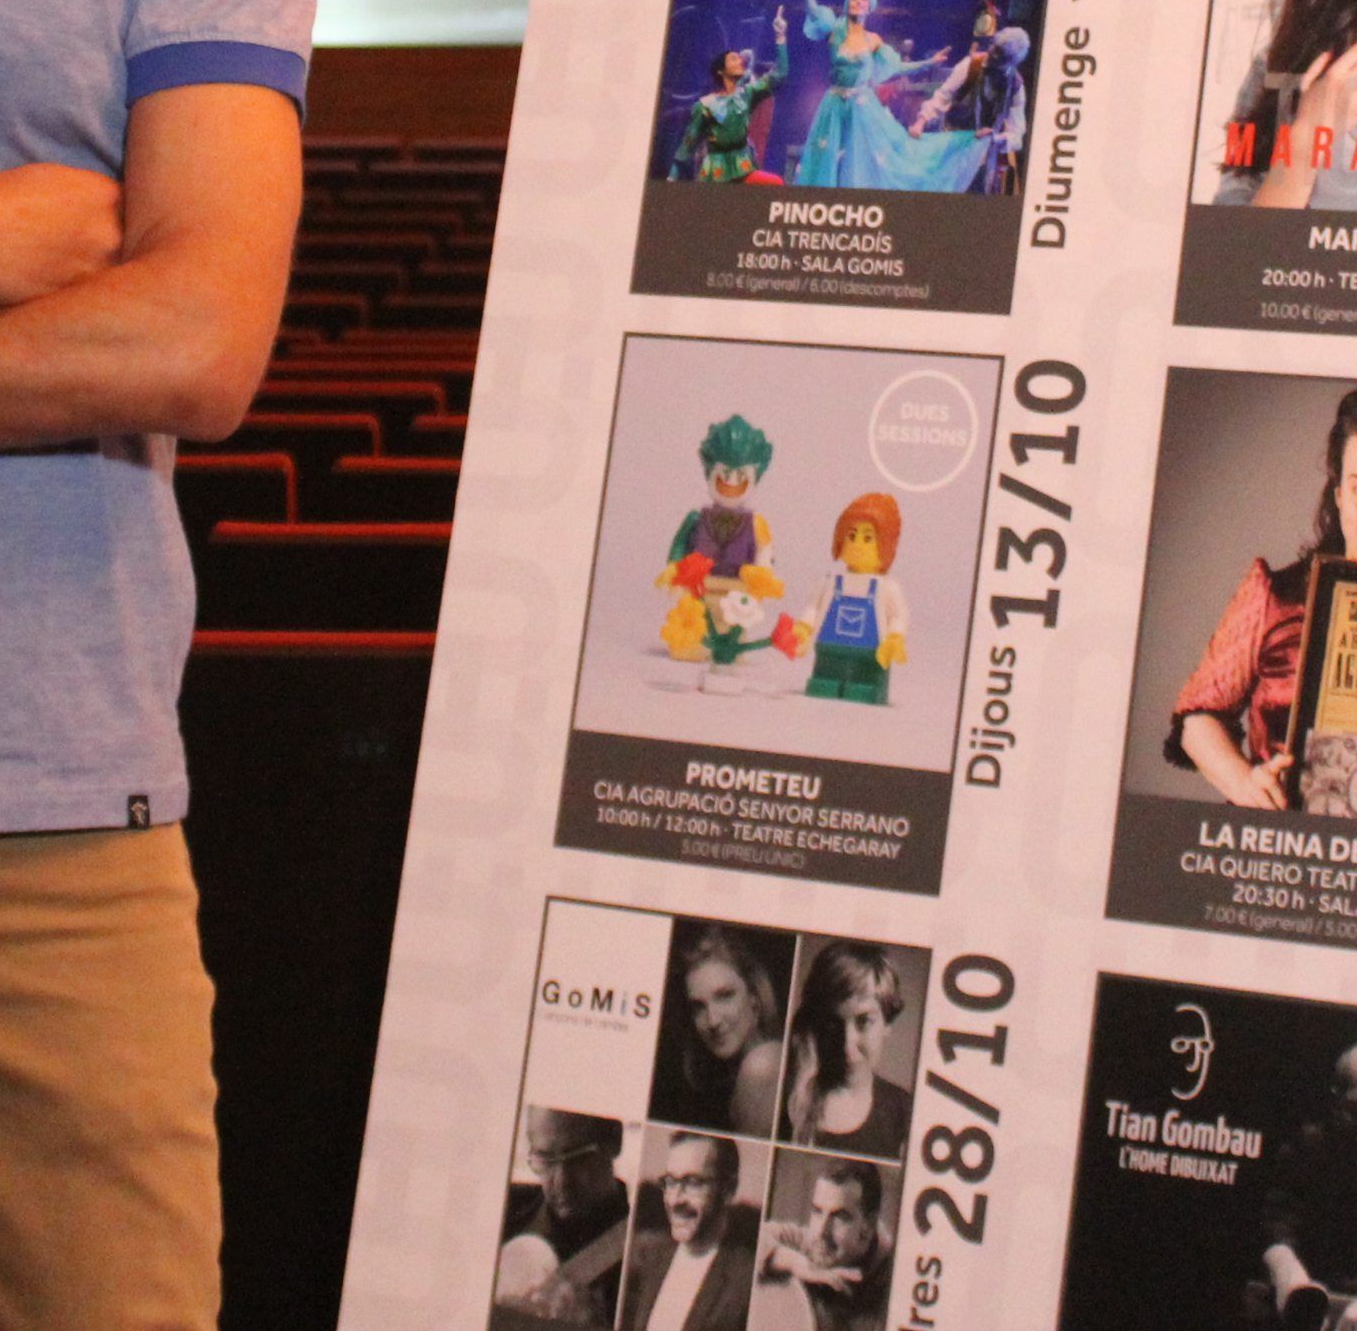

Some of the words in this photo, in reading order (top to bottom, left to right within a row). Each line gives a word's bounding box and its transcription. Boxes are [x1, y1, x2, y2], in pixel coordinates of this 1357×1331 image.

[1031, 25, 1097, 250] Diumenge
[768, 201, 884, 229] PINOCHO
[752, 228, 783, 248] CIA
[787, 230, 893, 254] TRENCADÍS
[736, 252, 778, 270] 18:00
[801, 255, 844, 274] SALA
[848, 257, 904, 277] GOMIS
[1262, 268, 1311, 288] 20:00
[901, 401, 949, 422] DUES
[987, 358, 1087, 630] 13/10
[965, 644, 1016, 789] Dijous
[685, 761, 822, 800] PROMETEU
[593, 780, 624, 802] CIA
[626, 785, 735, 816] AGRUPACIÓ
[737, 798, 813, 826] SENYOR
[817, 808, 910, 837] SERRANO
[596, 807, 639, 826] 10:00
[665, 815, 707, 836] 12:00
[731, 821, 794, 847] TEATRE
[796, 829, 902, 860] ECHEGARAY
[1199, 821, 1235, 849] LA
[1241, 825, 1323, 860] REINA
[1180, 851, 1215, 875] CIA
[1219, 855, 1302, 886] QUIERO
[1232, 883, 1289, 908] 20:30
[913, 952, 1016, 1245] 28/10
[1105, 1099, 1157, 1143] Tian
[1161, 1109, 1263, 1159] Gombau
